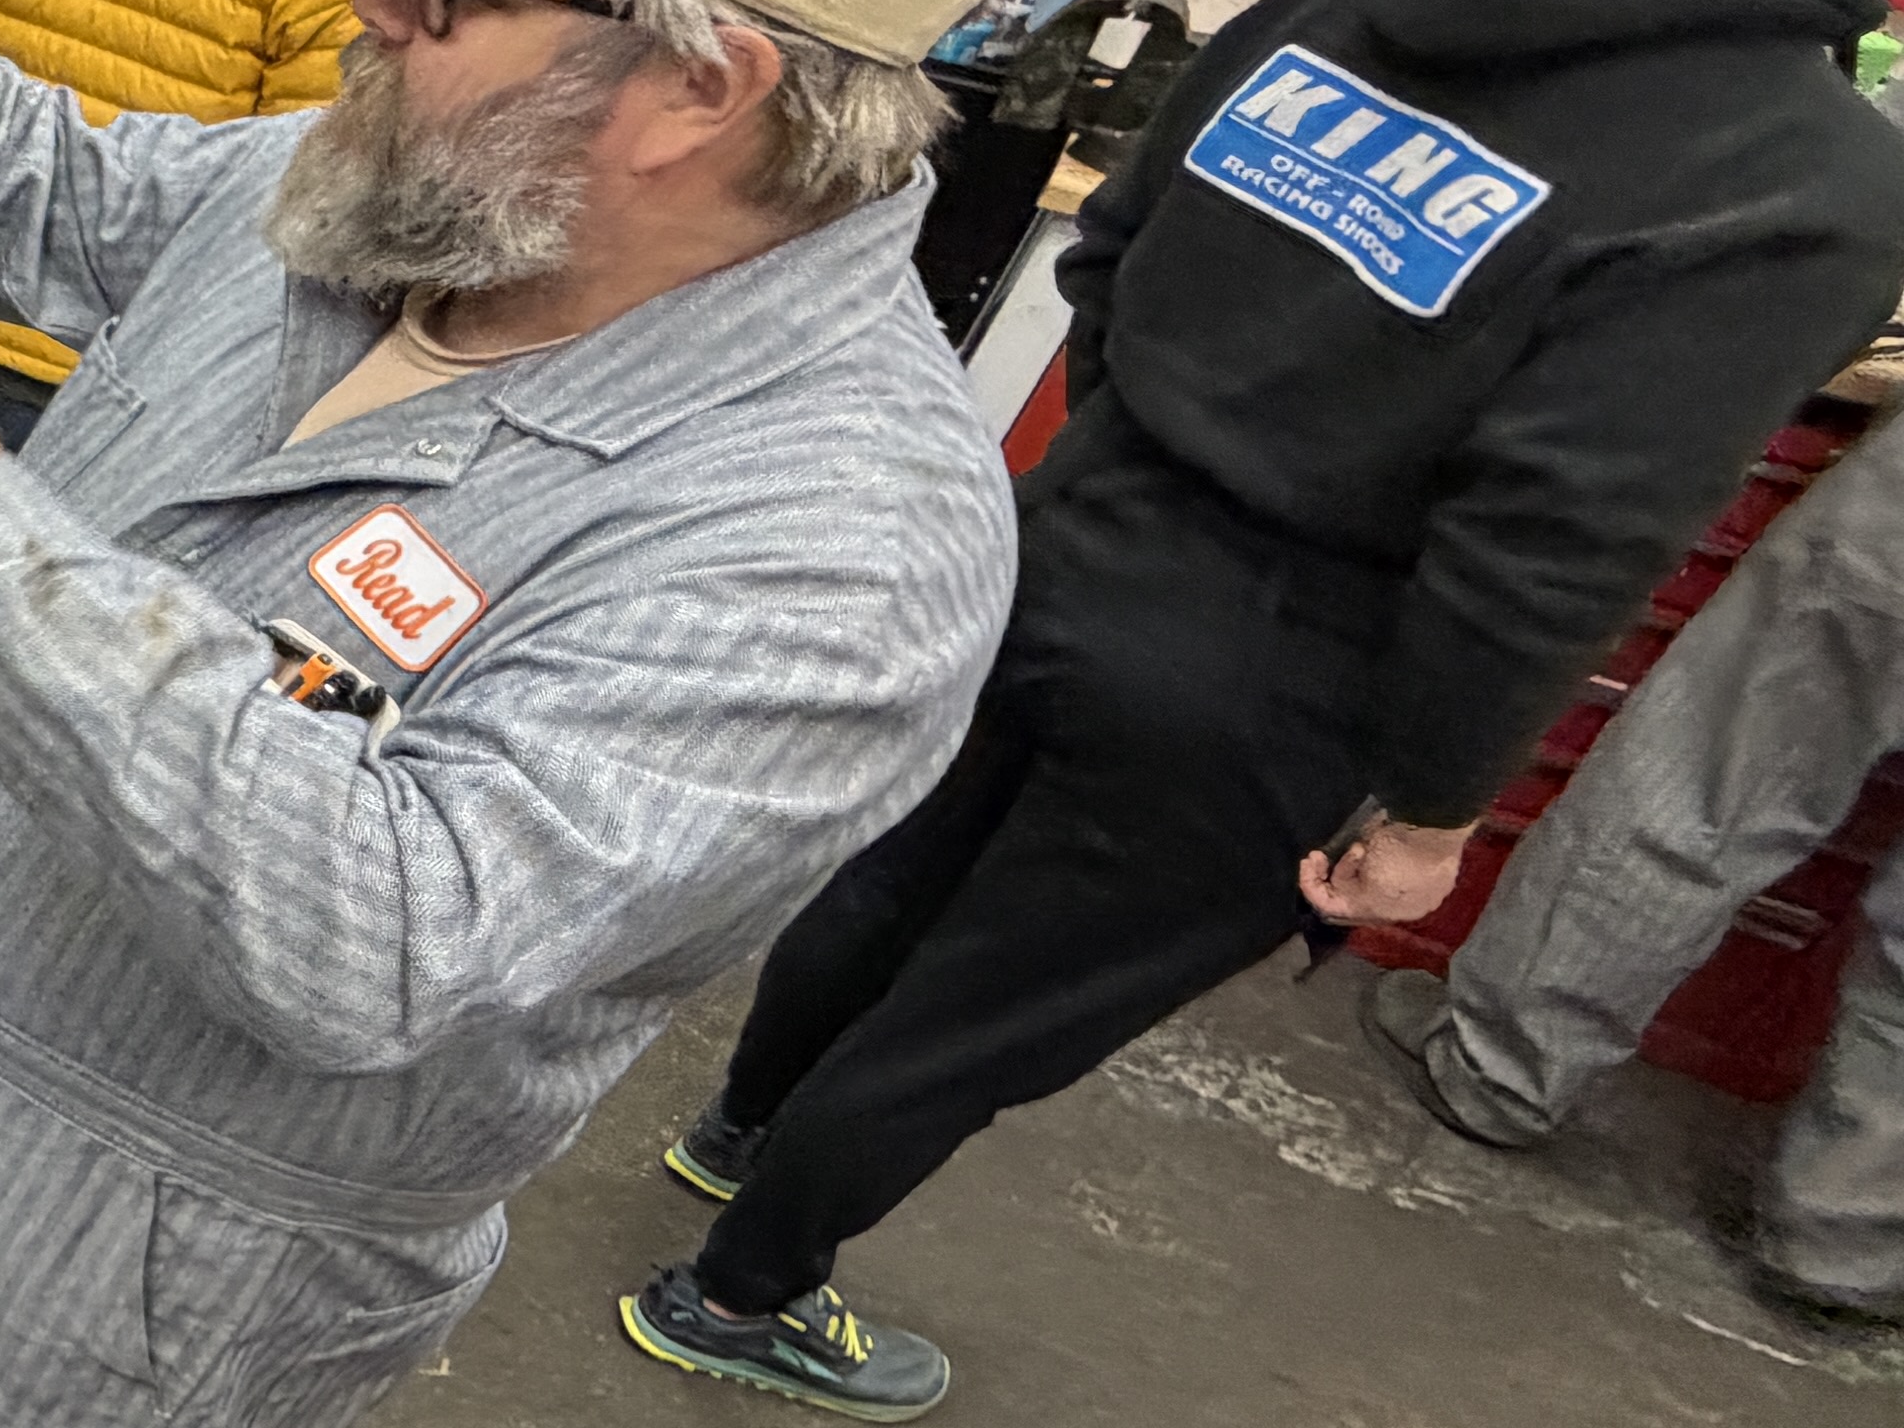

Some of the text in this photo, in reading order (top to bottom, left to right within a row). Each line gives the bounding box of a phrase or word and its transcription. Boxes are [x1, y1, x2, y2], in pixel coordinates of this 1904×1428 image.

[1219, 154, 1406, 277] RACING SHOCKS
[1235, 69, 1519, 239] KING
